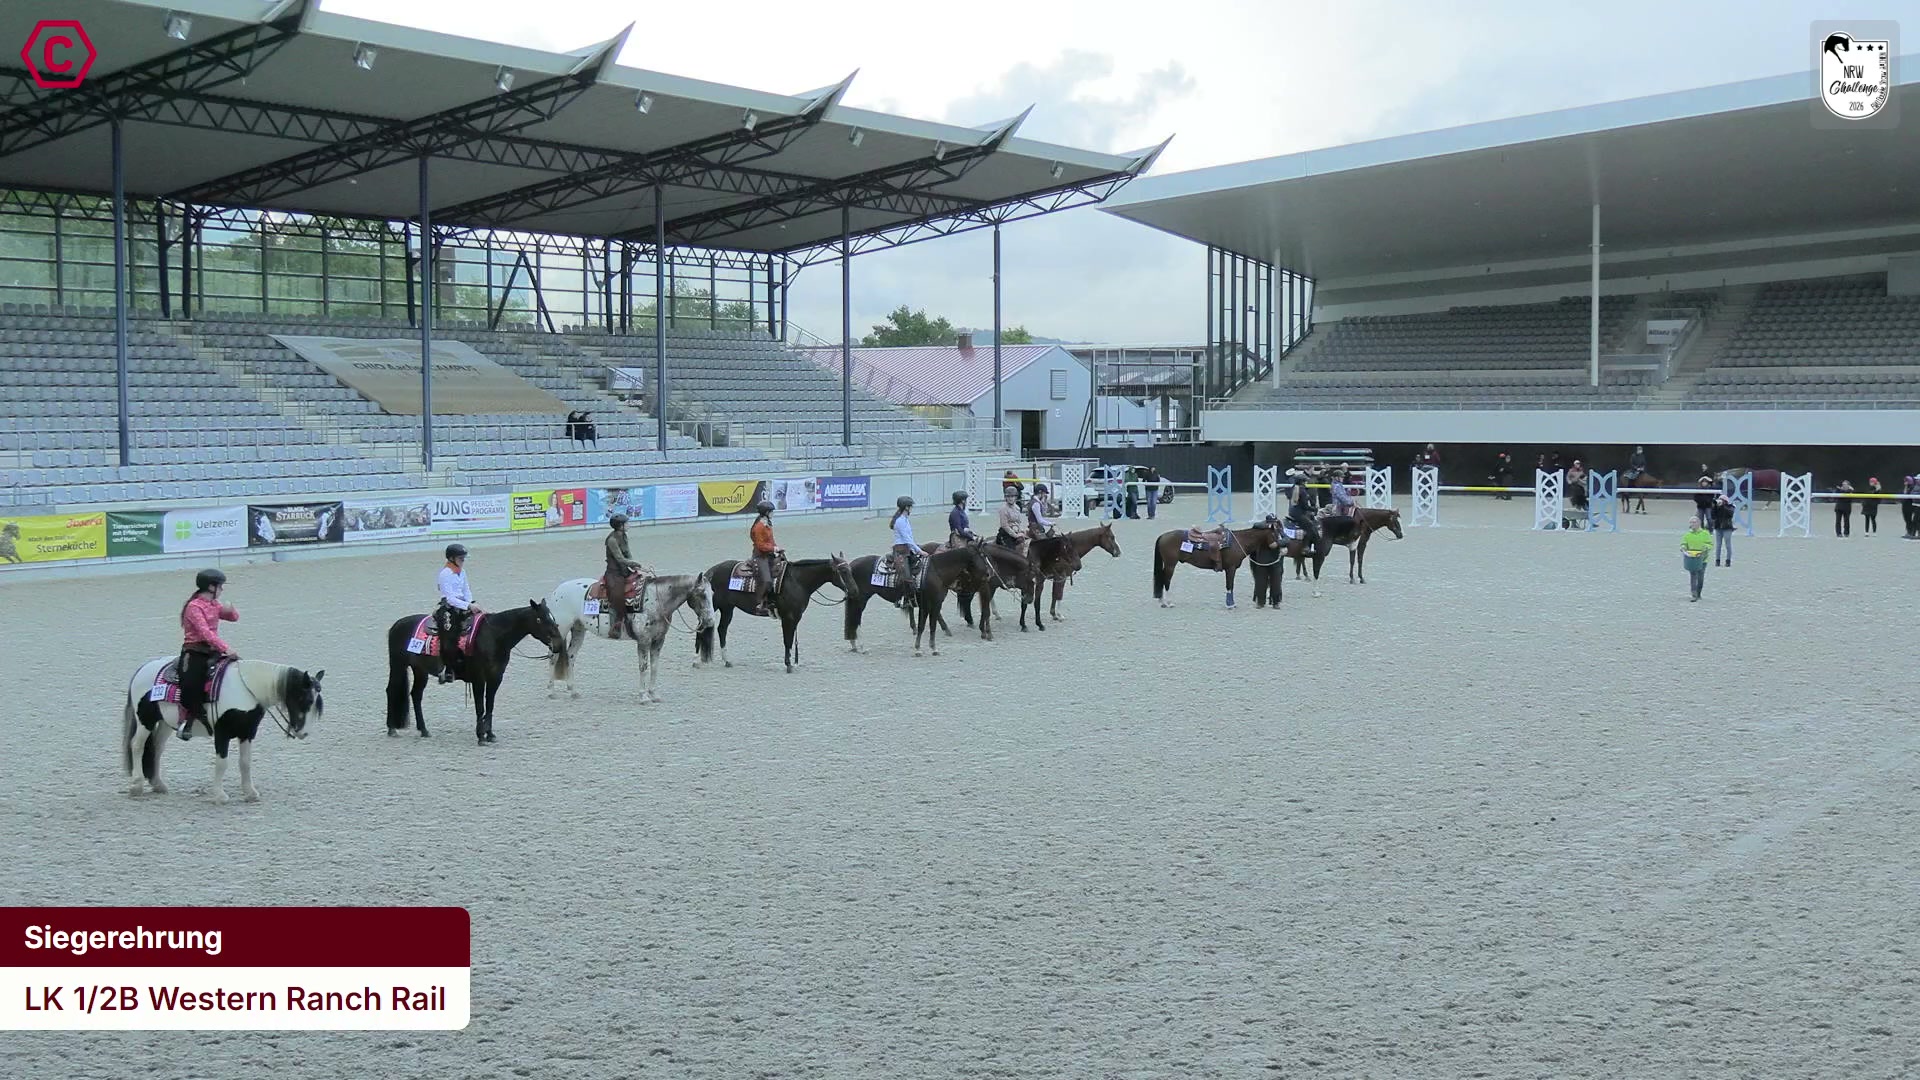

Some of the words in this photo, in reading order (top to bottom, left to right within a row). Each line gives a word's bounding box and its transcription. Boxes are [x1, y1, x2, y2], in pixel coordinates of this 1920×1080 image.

[824, 483, 867, 497] AMERICANA
[712, 493, 742, 505] marstall
[433, 500, 471, 516] JUNG
[471, 506, 506, 515] PROGRAMM
[276, 510, 316, 521] STARBUCK
[196, 519, 239, 529] Uelzener
[36, 540, 97, 554] Sterneküche!
